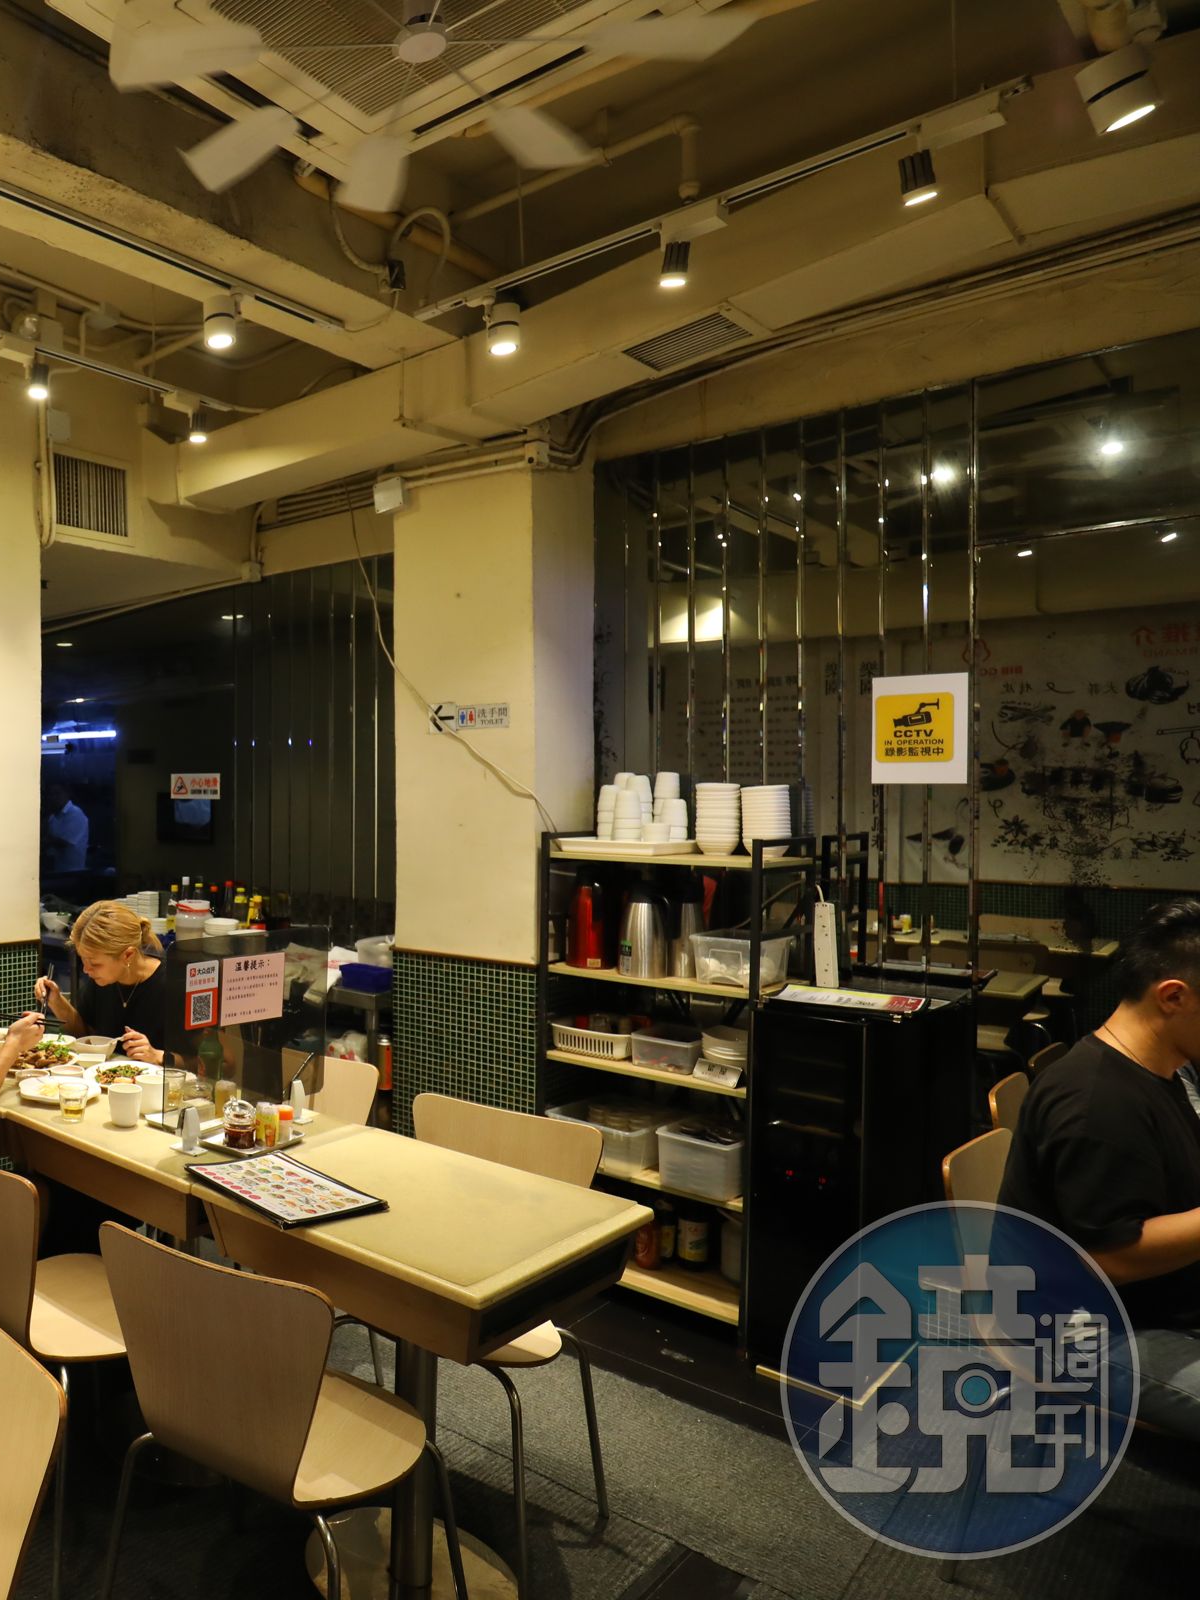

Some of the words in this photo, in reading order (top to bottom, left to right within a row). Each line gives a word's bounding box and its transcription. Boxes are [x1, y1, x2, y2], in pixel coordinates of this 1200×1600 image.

[478, 707, 508, 718] 洗手間
[893, 729, 934, 738] CCTV
[896, 738, 944, 746] OPERATION
[884, 746, 944, 757] 錄影監視中
